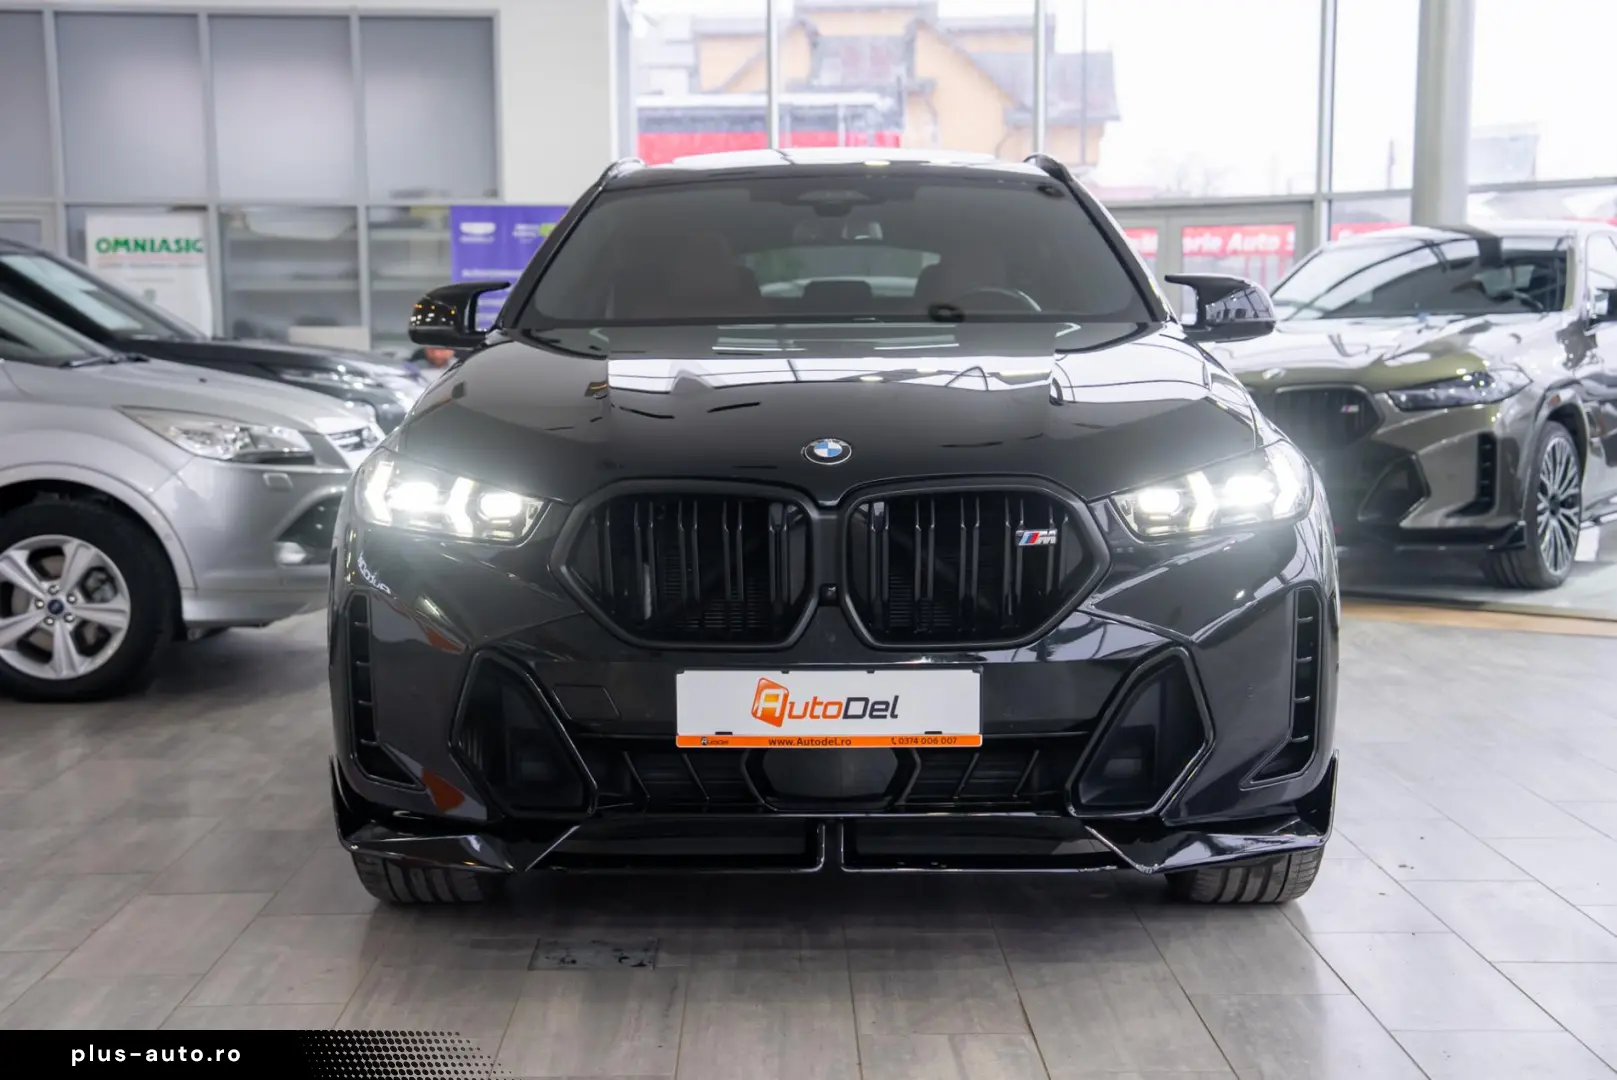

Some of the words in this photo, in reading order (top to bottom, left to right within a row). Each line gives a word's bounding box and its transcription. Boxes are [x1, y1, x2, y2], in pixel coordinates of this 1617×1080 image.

[751, 677, 899, 727] AutoDel
[768, 737, 852, 747] www.Autodel.ro
[898, 736, 919, 745] 0374
[920, 736, 939, 746] 006
[940, 736, 957, 745] 007
